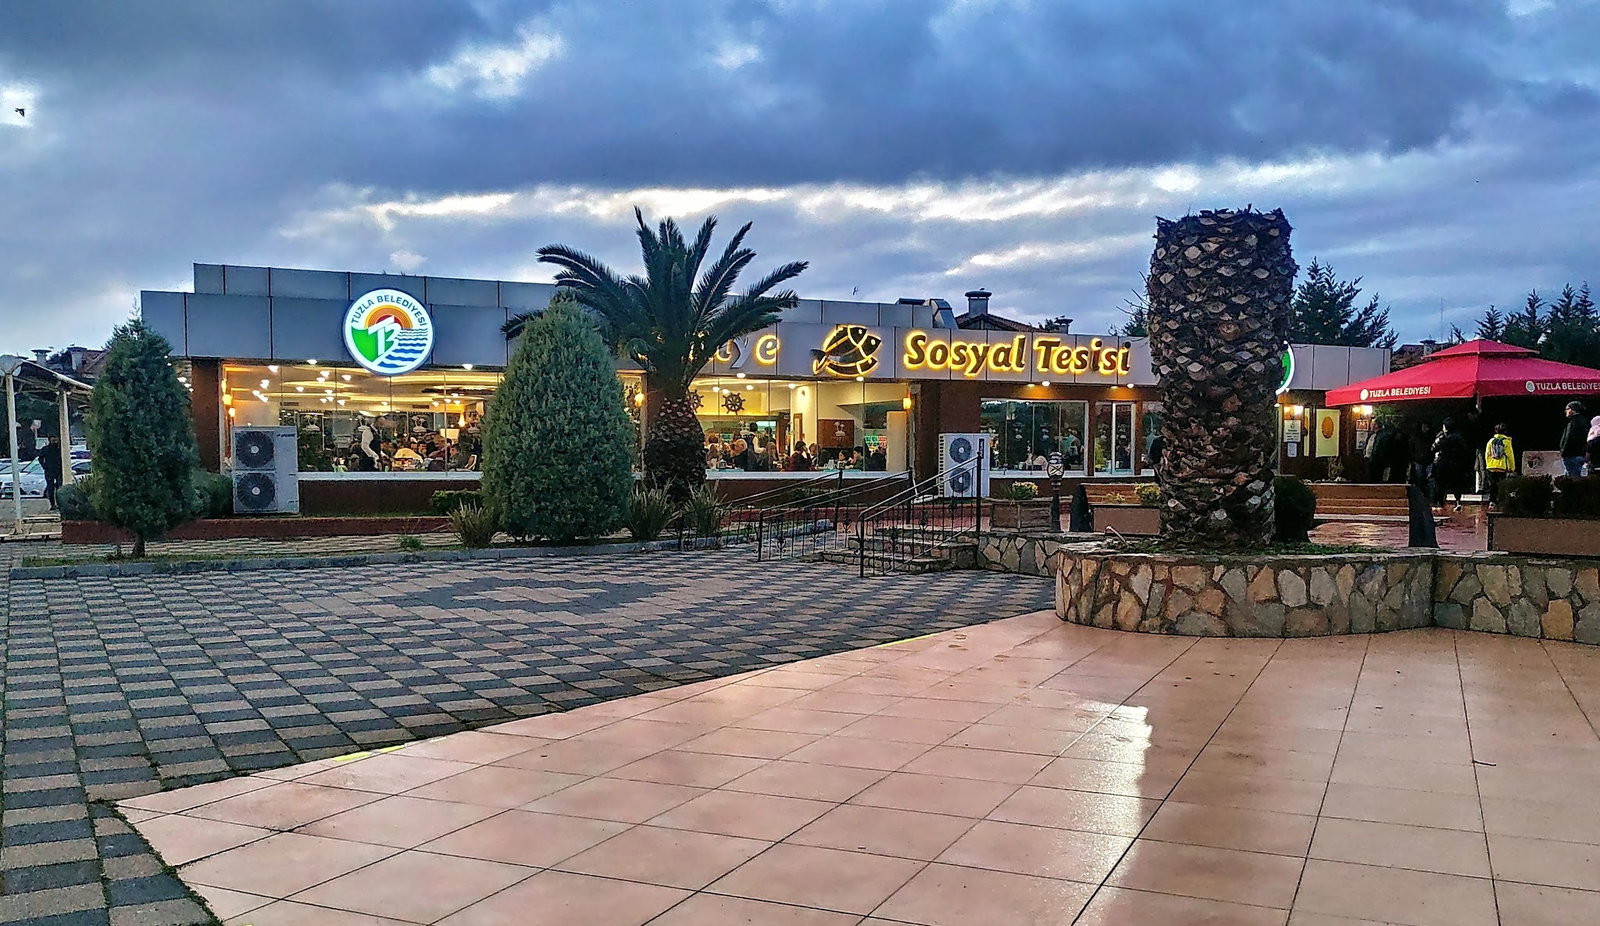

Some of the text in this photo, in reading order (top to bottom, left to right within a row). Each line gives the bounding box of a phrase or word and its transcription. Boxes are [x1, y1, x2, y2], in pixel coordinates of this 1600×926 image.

[351, 299, 375, 324] TUZLA
[906, 334, 1132, 375] Sosyal Tesisi
[1369, 389, 1390, 398] TUZLA
[1535, 382, 1561, 391] TUZLA
